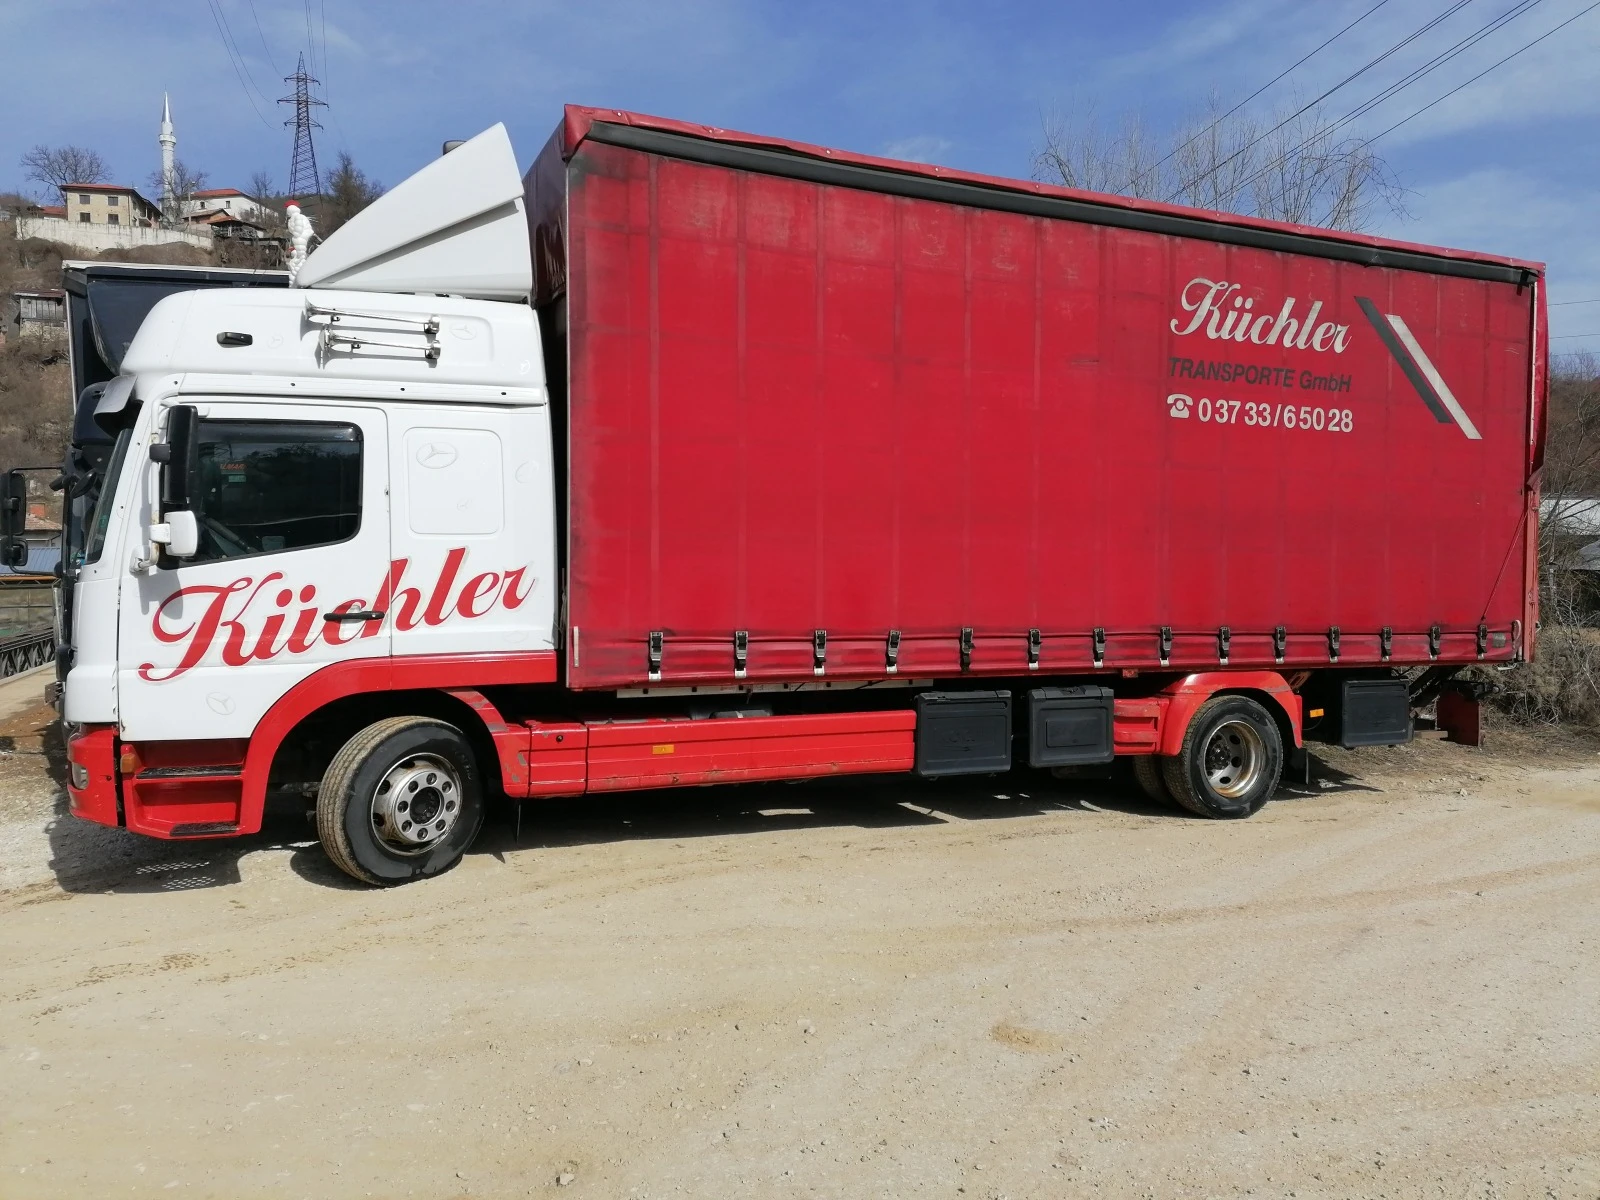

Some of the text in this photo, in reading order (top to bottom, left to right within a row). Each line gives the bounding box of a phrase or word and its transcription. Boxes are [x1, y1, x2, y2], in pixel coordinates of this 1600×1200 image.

[1169, 277, 1352, 353] Küchler
[1169, 357, 1352, 392] TRANSPORTE GmbH
[138, 547, 536, 682] Küchler
